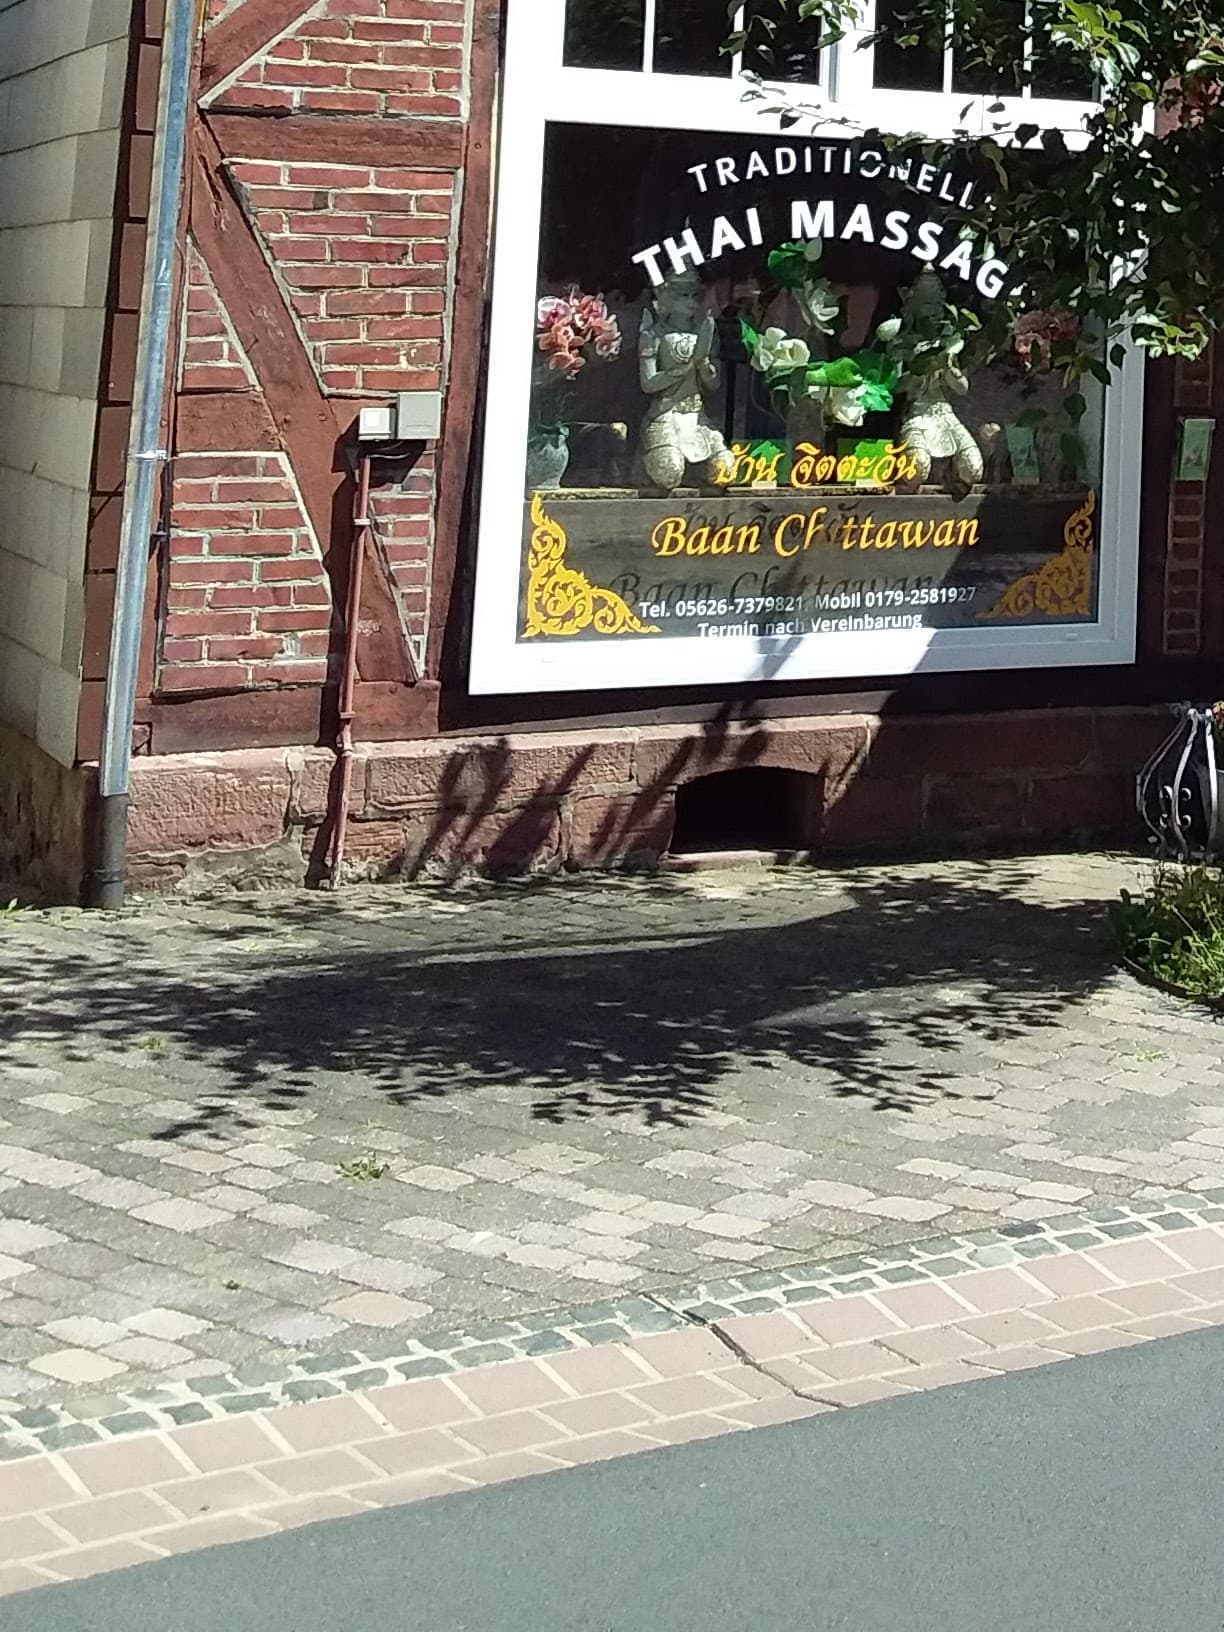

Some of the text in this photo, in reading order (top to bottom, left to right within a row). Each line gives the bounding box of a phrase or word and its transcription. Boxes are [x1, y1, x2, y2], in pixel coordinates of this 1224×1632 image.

[686, 146, 997, 211] TRADITIONELL
[631, 200, 1026, 300] THAI MASSAG
[651, 516, 761, 558] Baan
[639, 601, 671, 618] Tel.
[815, 590, 861, 610] Mobil
[865, 586, 976, 608] 0179-2581927
[697, 613, 923, 638] Termin nach Vereinbarung
